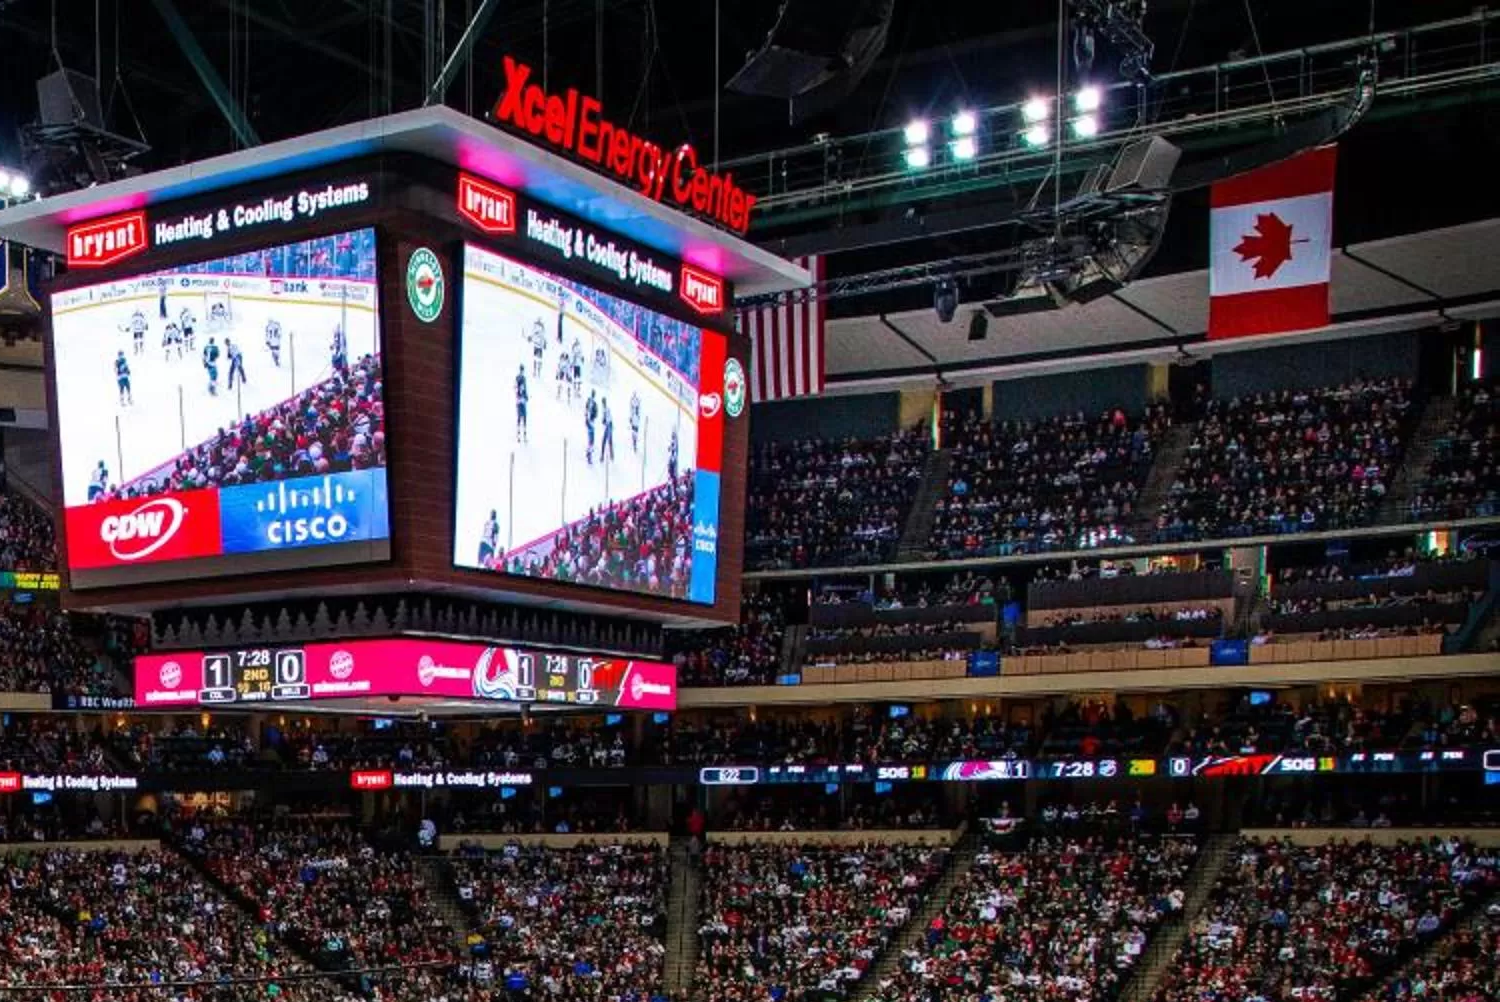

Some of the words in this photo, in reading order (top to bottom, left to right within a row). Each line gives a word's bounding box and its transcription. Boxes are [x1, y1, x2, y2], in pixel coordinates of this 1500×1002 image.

[673, 144, 757, 233] Center
[73, 221, 135, 258] bryant
[155, 217, 212, 245] Heating
[217, 209, 229, 231] &
[234, 196, 293, 227] Cooling
[298, 182, 369, 216] Systems
[464, 186, 509, 225] bryant
[527, 210, 572, 258] Heating
[574, 230, 584, 254] &
[587, 234, 627, 279] Cooling
[630, 252, 673, 292] Systems
[685, 274, 718, 306] bryant
[101, 510, 165, 542] CDW
[267, 513, 348, 544] CISCO
[237, 650, 270, 666] 7:28
[281, 654, 300, 682] 0
[521, 657, 529, 685] 1
[209, 659, 222, 685] 1
[243, 668, 269, 681] 2ND
[581, 662, 590, 688] 0
[877, 767, 909, 779] SOG
[1053, 761, 1094, 777] 7:28
[1174, 759, 1185, 774] 0
[1280, 757, 1316, 771] SOG
[22, 775, 54, 790] Heating
[65, 775, 98, 791] Cooling
[100, 775, 137, 791] Systems
[393, 773, 433, 788] Heating
[446, 772, 485, 788] Cooling
[487, 772, 532, 788] Systems
